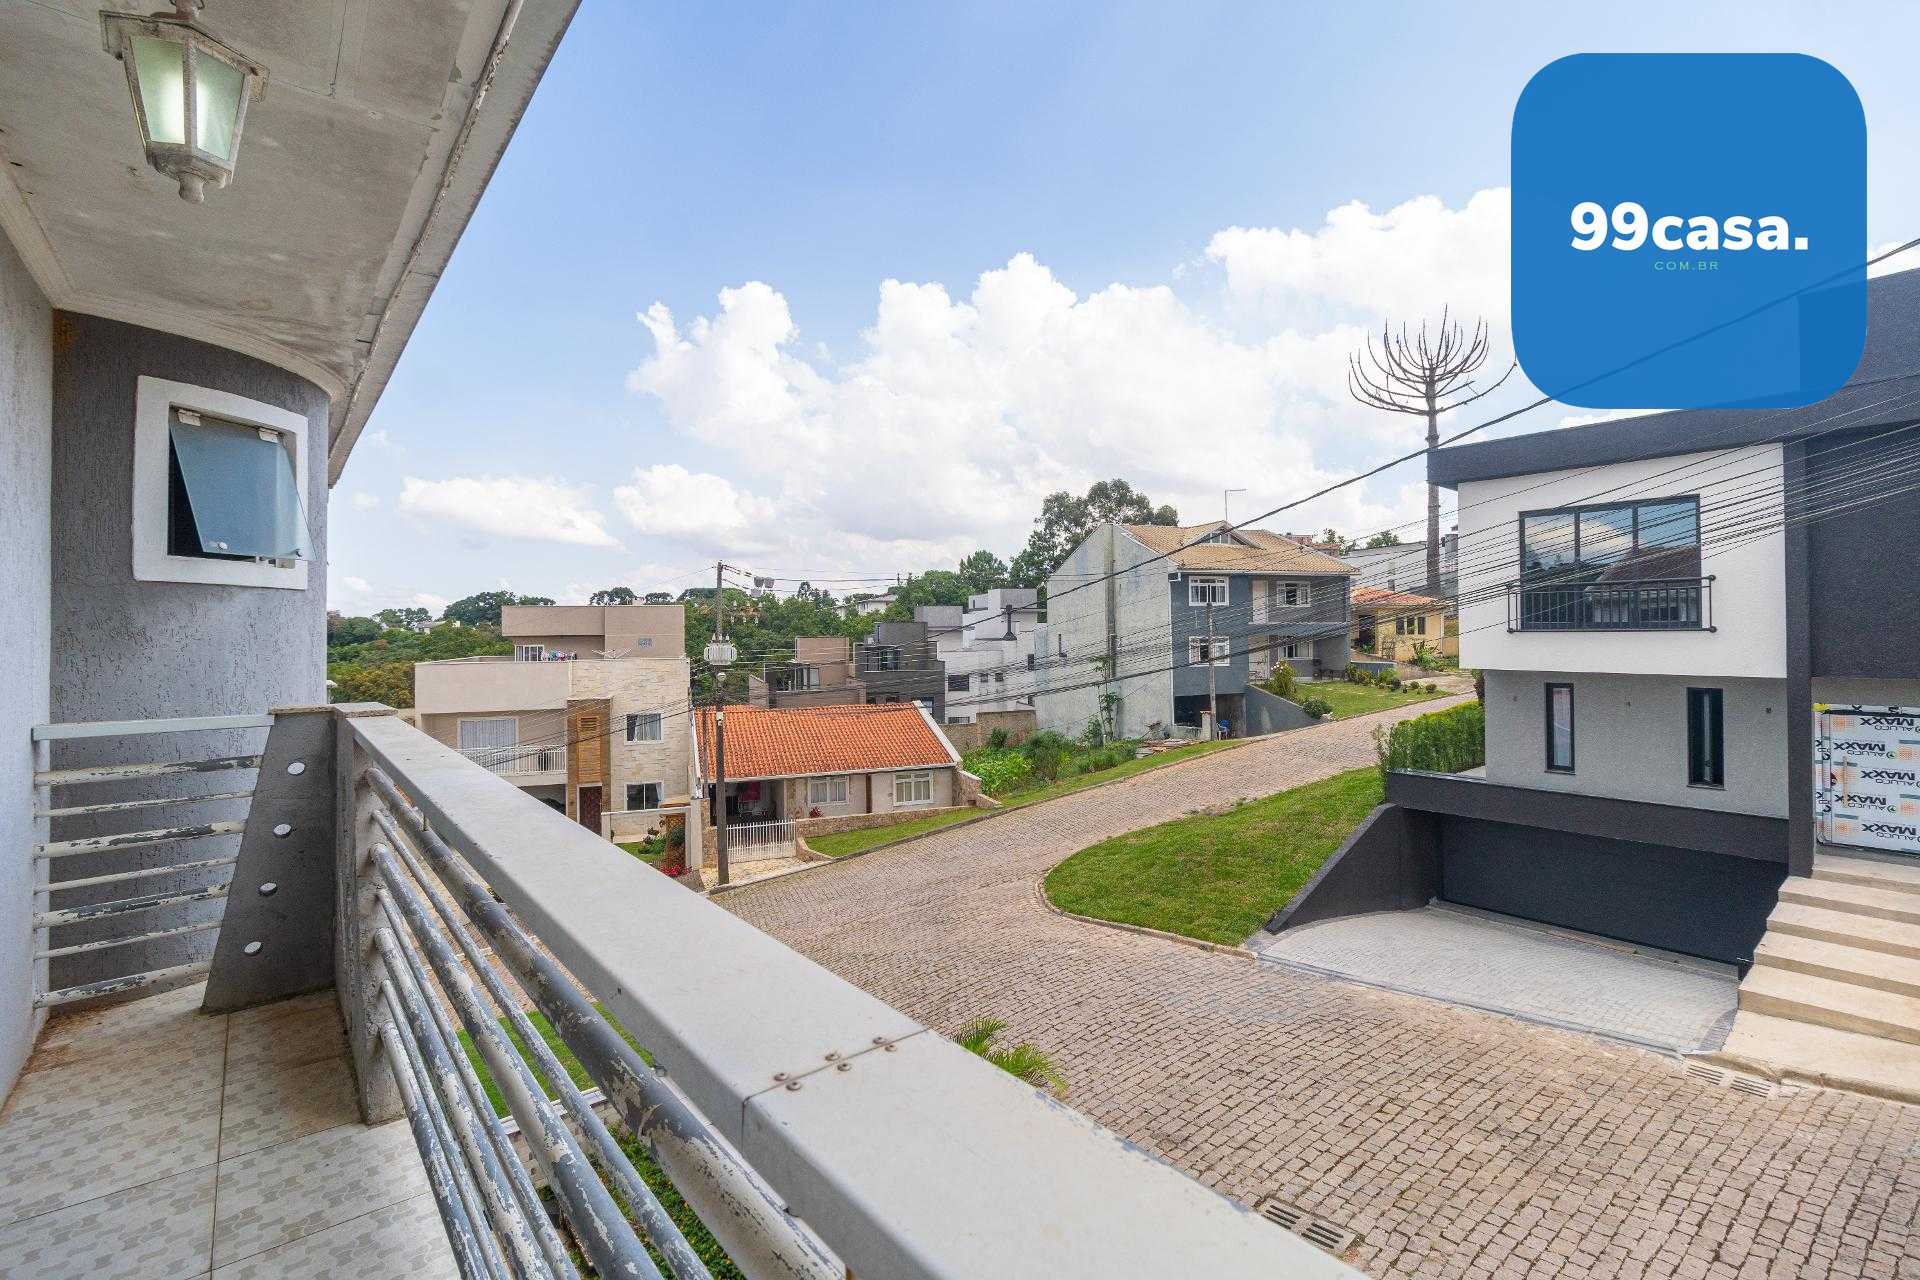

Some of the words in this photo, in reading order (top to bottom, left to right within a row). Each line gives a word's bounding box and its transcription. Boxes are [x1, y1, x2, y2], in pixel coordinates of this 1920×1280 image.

[1860, 716, 1915, 726] MAXX
[1833, 742, 1886, 752] MAXX
[1861, 770, 1916, 781] MAXX
[1861, 823, 1917, 836] MAXX
